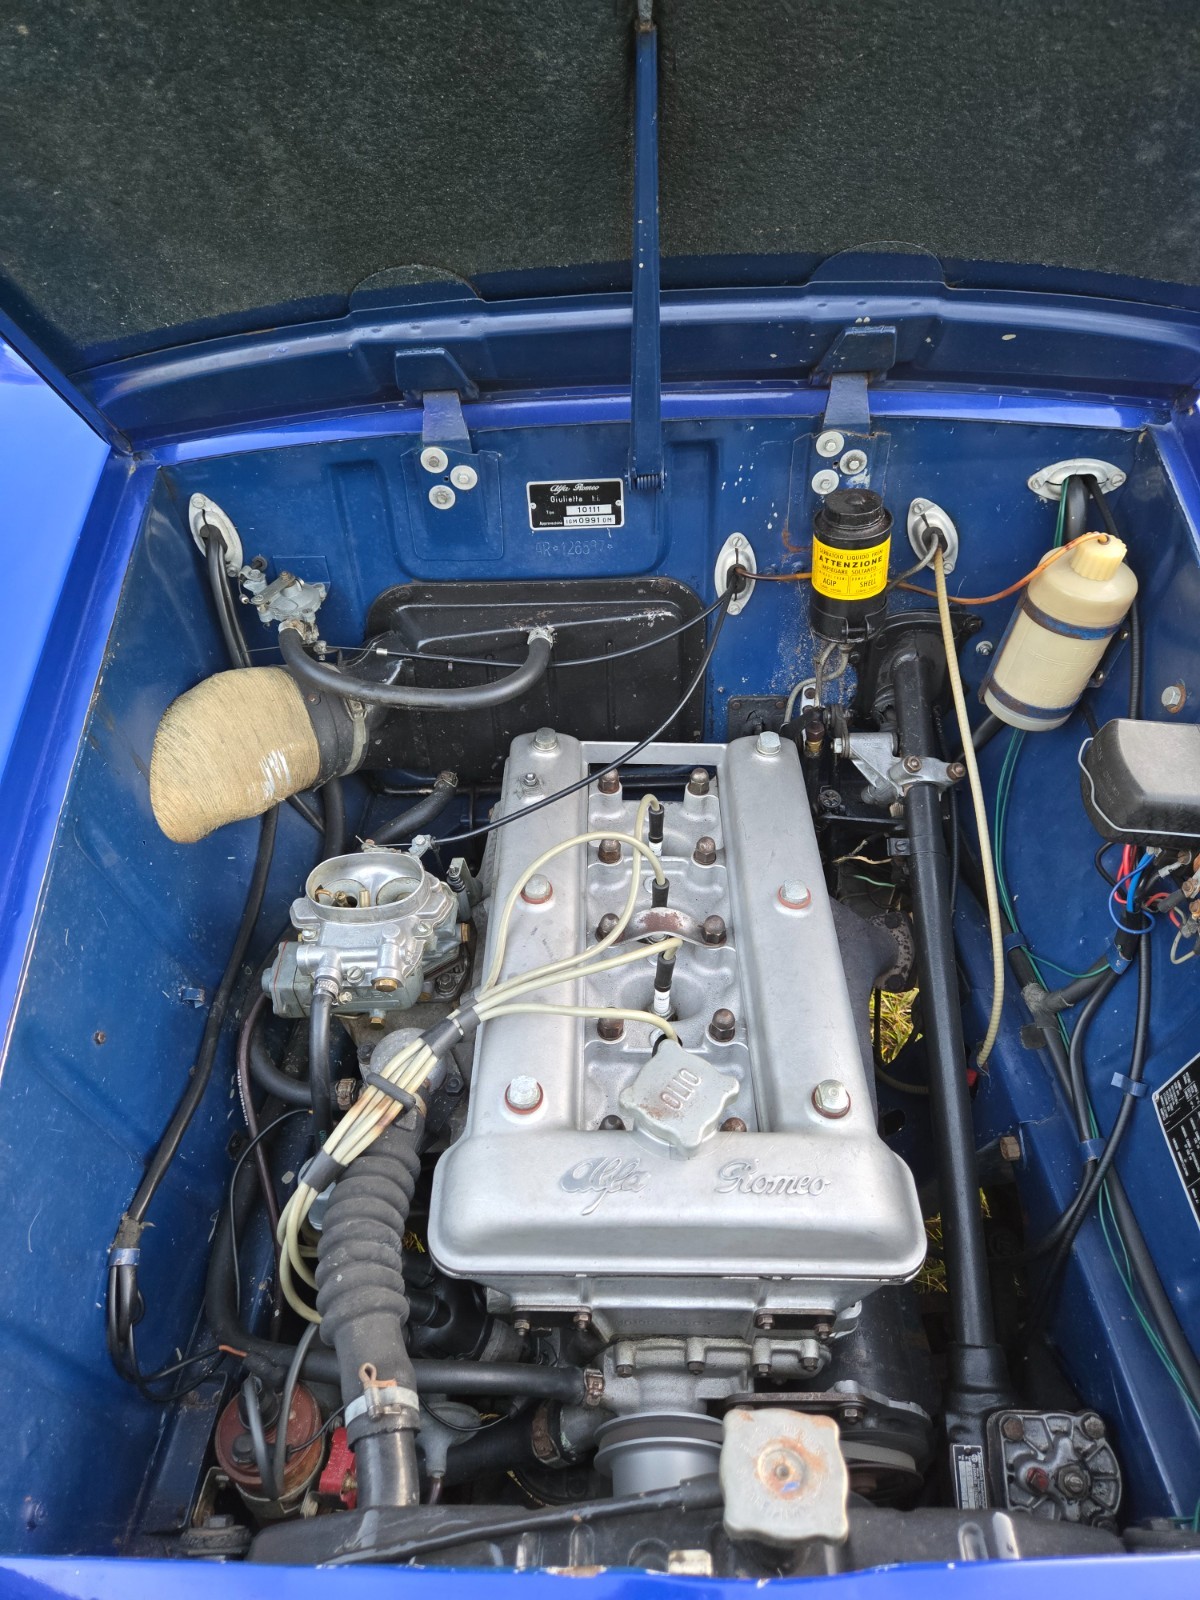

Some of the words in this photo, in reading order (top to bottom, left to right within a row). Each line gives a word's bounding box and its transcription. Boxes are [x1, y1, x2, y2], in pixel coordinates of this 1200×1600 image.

[550, 484, 570, 495] Alfa
[572, 483, 600, 492] Romeo
[550, 495, 583, 503] Giulietta
[577, 506, 600, 514] 10111
[819, 554, 883, 568] ATTENZIONE
[851, 566, 877, 575] SOLTANTO
[822, 578, 837, 587] AGIP
[859, 578, 876, 588] SHELL
[660, 1068, 702, 1111] OLIO
[559, 1157, 651, 1216] Alfa
[714, 1157, 831, 1197] Romeo
